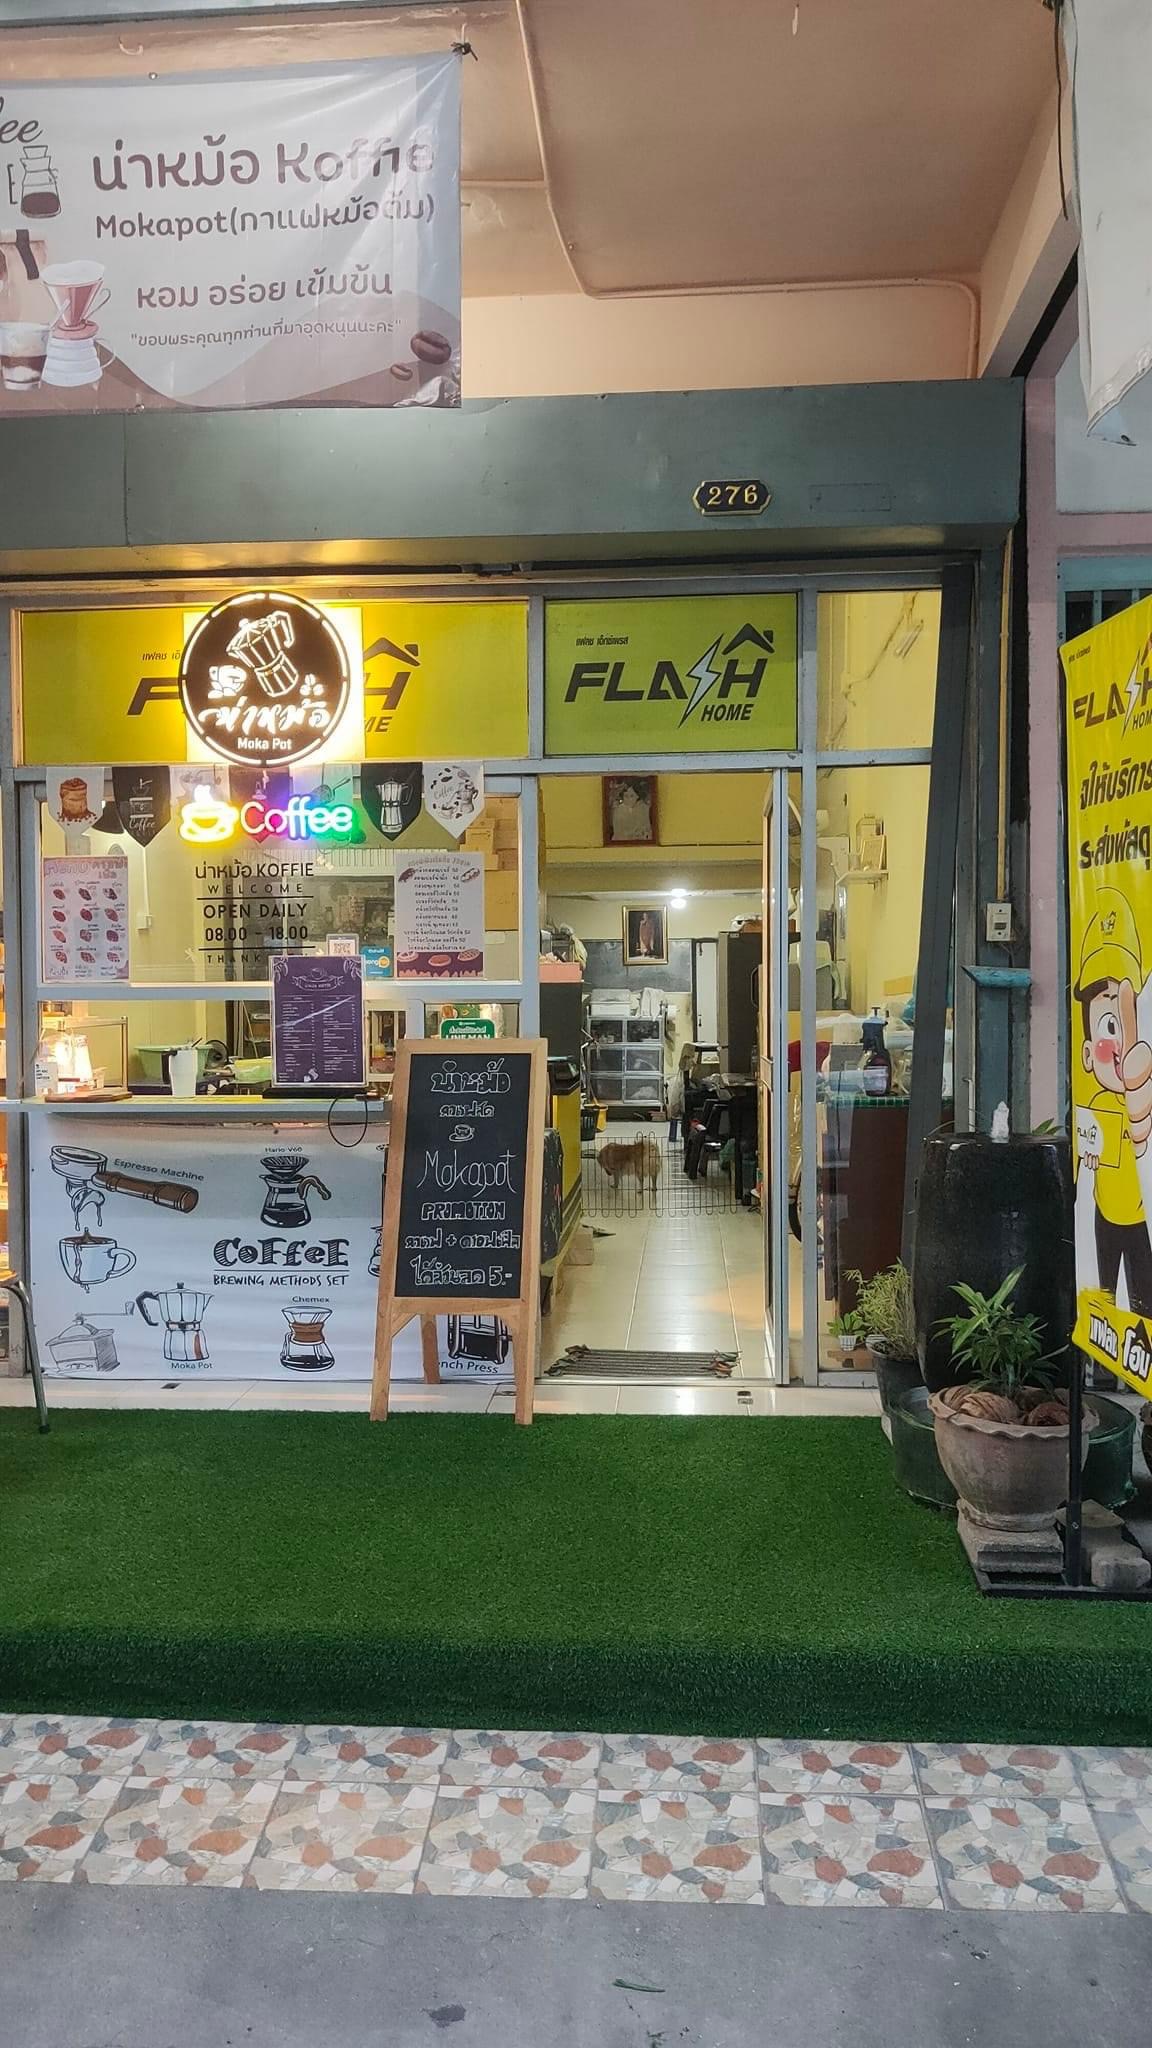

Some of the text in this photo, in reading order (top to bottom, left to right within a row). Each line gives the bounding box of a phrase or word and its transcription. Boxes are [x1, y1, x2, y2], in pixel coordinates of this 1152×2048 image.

[92, 134, 261, 191] น่าหม้อ
[137, 263, 393, 309] หอม อร่อย เข้มข้น
[707, 485, 759, 506] 276
[701, 704, 755, 721] HOME
[238, 737, 293, 750] Moka Pot
[241, 797, 354, 840] Coffee
[195, 859, 315, 879] น่าหม้อ KOFFIE
[207, 884, 304, 895] WELCOME
[203, 903, 308, 918] OPEN DAILY
[205, 927, 247, 941] 08.00
[269, 926, 308, 940] 18.00
[207, 954, 261, 964] THANK
[113, 1157, 205, 1182] Espresso Machine
[416, 1149, 517, 1198] Mokapot
[420, 1201, 506, 1220] PROMOTION
[213, 1273, 350, 1287] BREWING METHODS SET
[291, 1295, 330, 1303] Chemex
[171, 1361, 213, 1370] Moka Pot
[439, 1359, 499, 1374] nch Press
